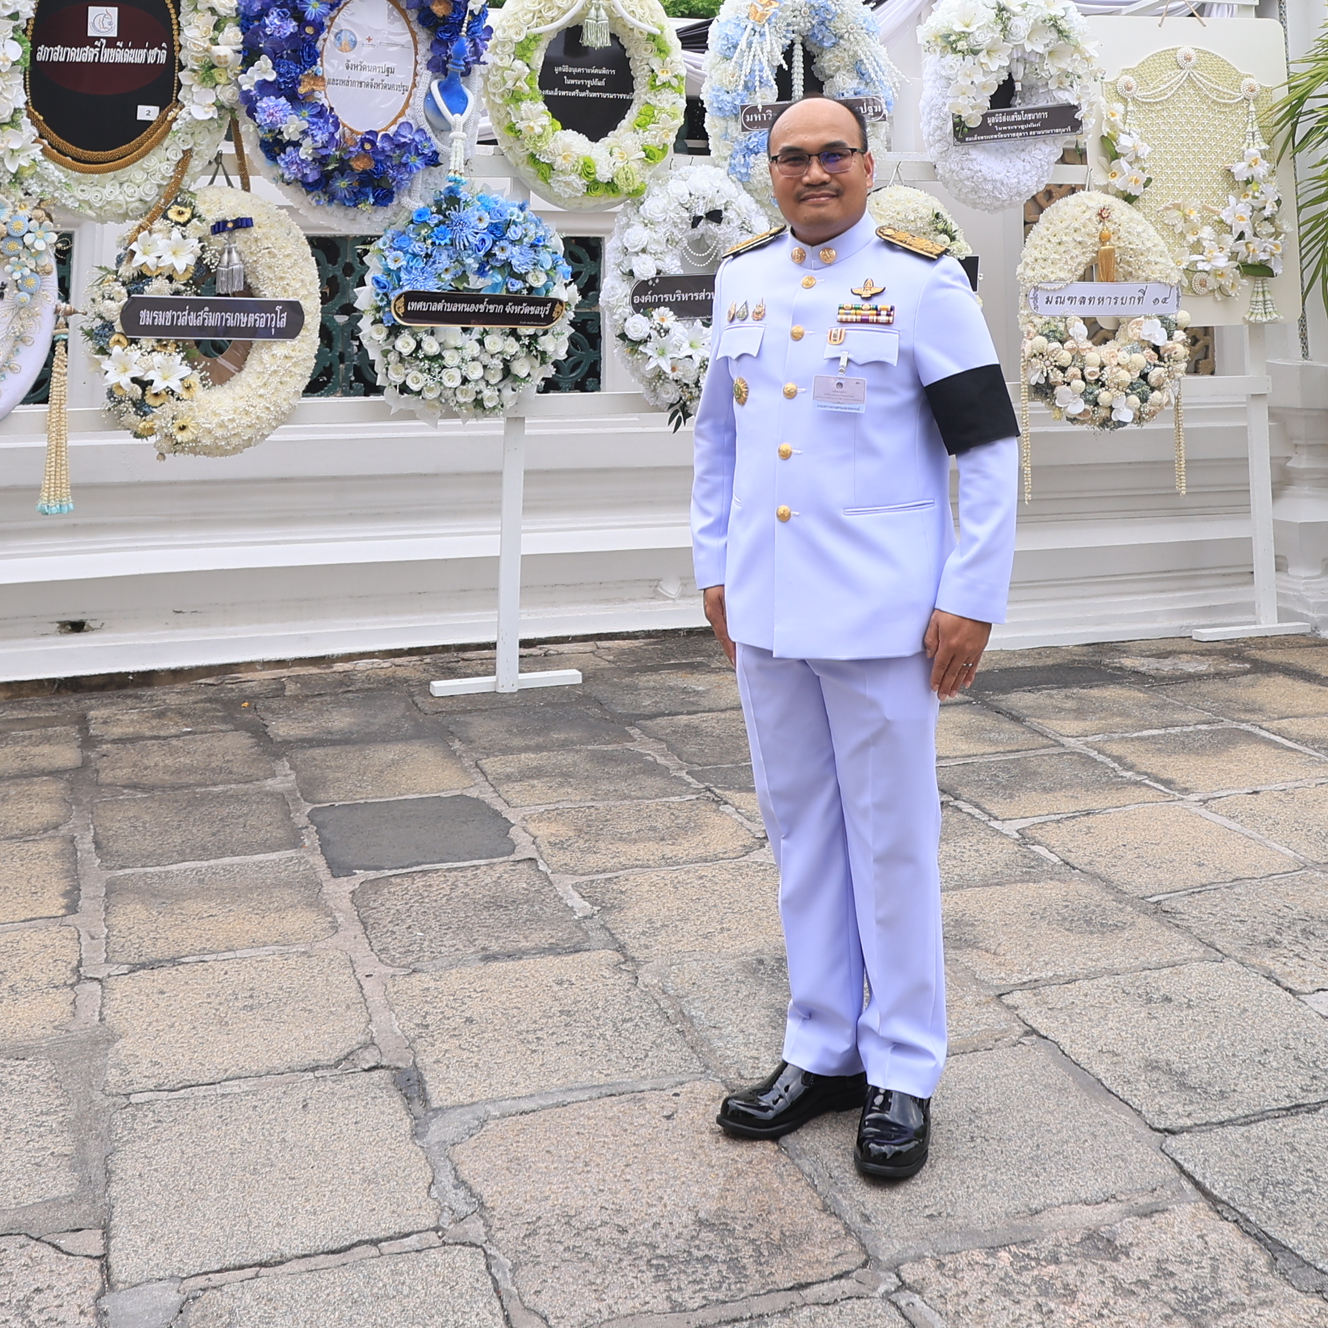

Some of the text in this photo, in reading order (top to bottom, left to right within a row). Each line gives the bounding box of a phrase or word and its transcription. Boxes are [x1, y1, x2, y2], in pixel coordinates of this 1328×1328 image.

[36, 38, 168, 65] สภาสมาคมสตรีไทยดีเด่นแห่งชาติ
[345, 59, 396, 77] จังหวัดนครปฐม
[145, 109, 152, 117] 2
[1045, 285, 1148, 306] มณฑลทหารบกที่
[139, 305, 287, 335] ชมรมชาวส่งเสริมการเกษตรอาวุโส
[504, 302, 552, 319] จังหวัดชลบุรี
